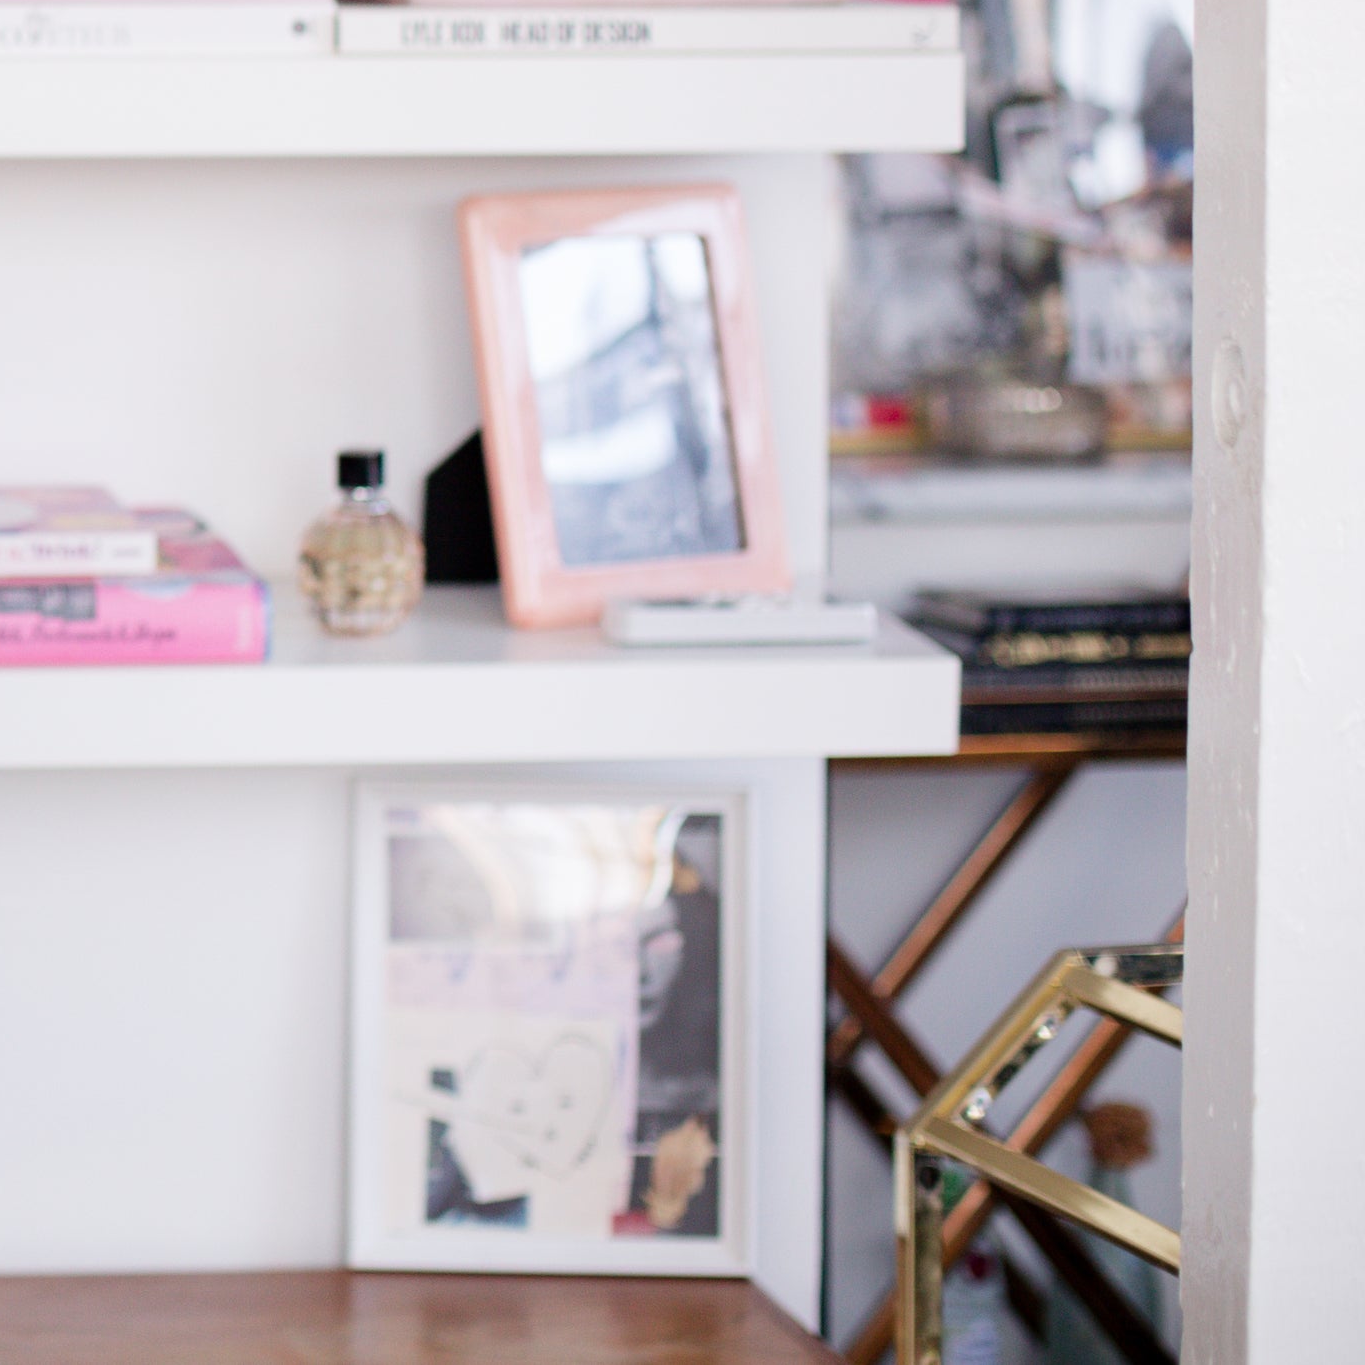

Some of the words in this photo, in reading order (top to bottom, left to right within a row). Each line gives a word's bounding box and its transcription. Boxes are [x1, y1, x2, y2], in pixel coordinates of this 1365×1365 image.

[500, 20, 548, 45] HEAD
[556, 20, 575, 45] OF
[582, 20, 653, 45] DESIGN
